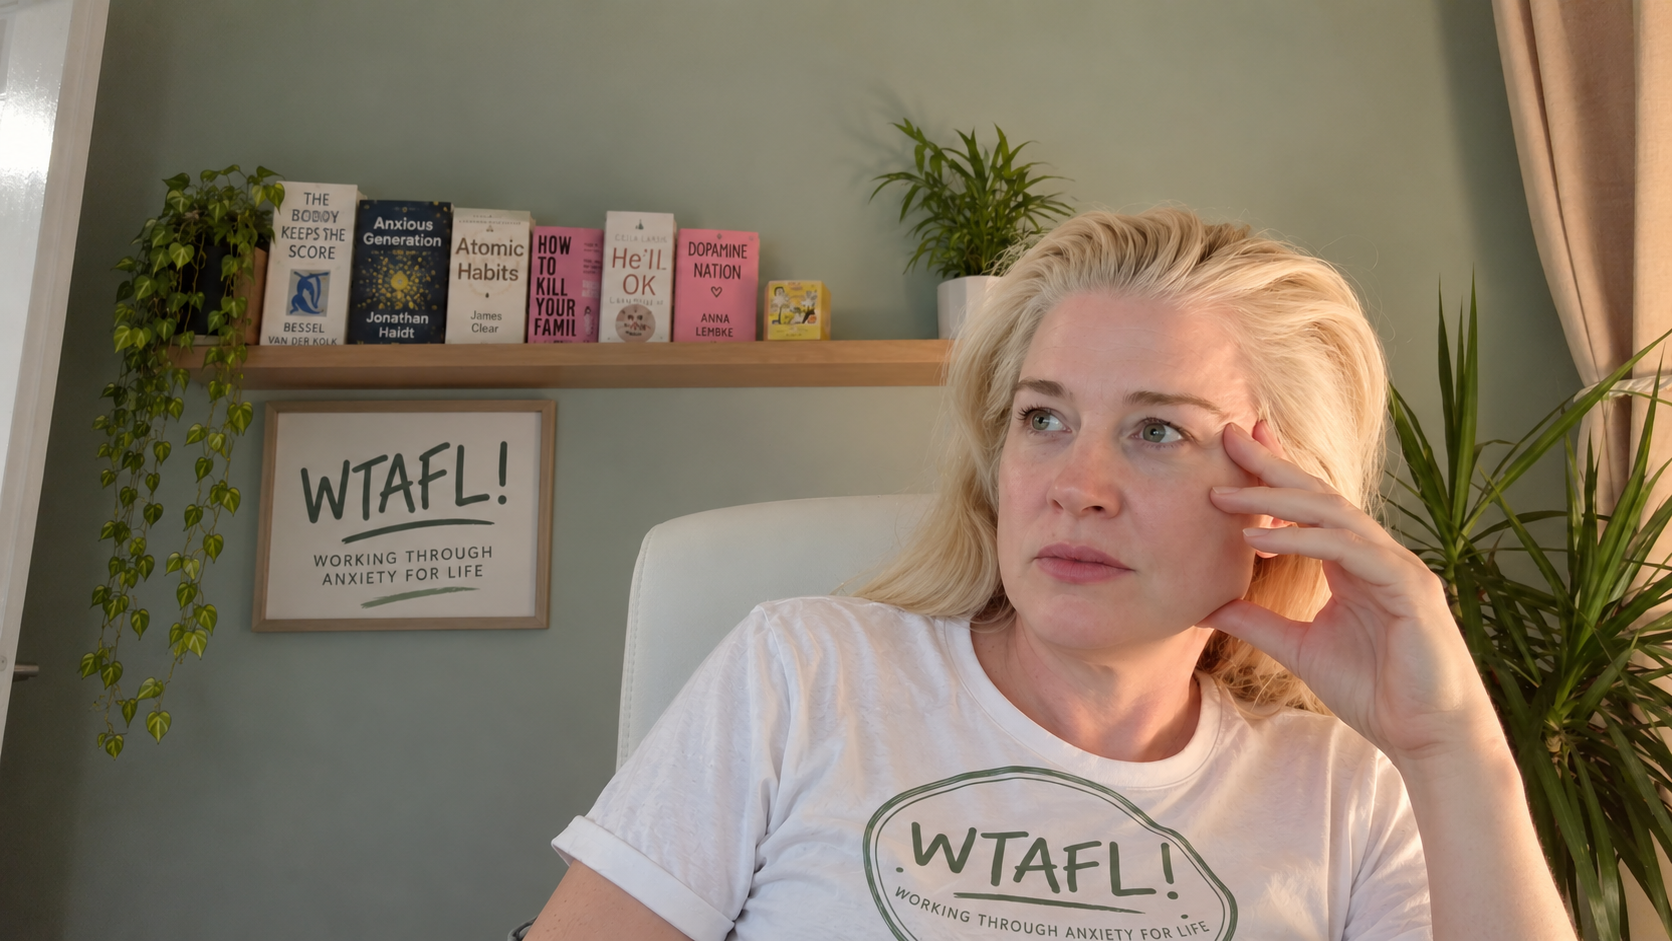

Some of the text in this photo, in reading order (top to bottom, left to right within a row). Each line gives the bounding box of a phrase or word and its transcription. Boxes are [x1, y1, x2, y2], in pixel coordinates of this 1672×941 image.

[304, 192, 329, 206] THE
[373, 216, 433, 231] Anxious
[281, 226, 346, 241] KEEPS THE
[363, 232, 442, 247] Generation
[288, 244, 336, 259] SCORE
[455, 237, 524, 257] Atomic
[538, 234, 572, 255] HOW
[688, 241, 748, 259] DOPAMINE
[458, 263, 519, 281] Habits
[537, 256, 556, 276] TO
[693, 263, 742, 280] NATION
[536, 277, 568, 296] KILL
[623, 273, 656, 296] OK
[470, 310, 502, 321] James
[536, 297, 576, 317] YOUR
[366, 312, 429, 324] Jonathan
[700, 313, 730, 324] ANNA
[284, 322, 325, 333] BESSEL
[379, 327, 415, 339] Haidt
[471, 323, 499, 333] Clear
[534, 318, 577, 337] FAMIL
[695, 326, 734, 337] LEMBKE
[268, 336, 338, 345] VAN DER KOLK
[301, 441, 508, 524] WTAFL!
[313, 546, 493, 567] WORKING THROUGH
[322, 564, 483, 586] ANXIETY FOR LIFE
[911, 821, 1179, 900] WTAFL!
[895, 886, 1210, 941] WORKING THROUGH ANXIETY FOR LIFE
